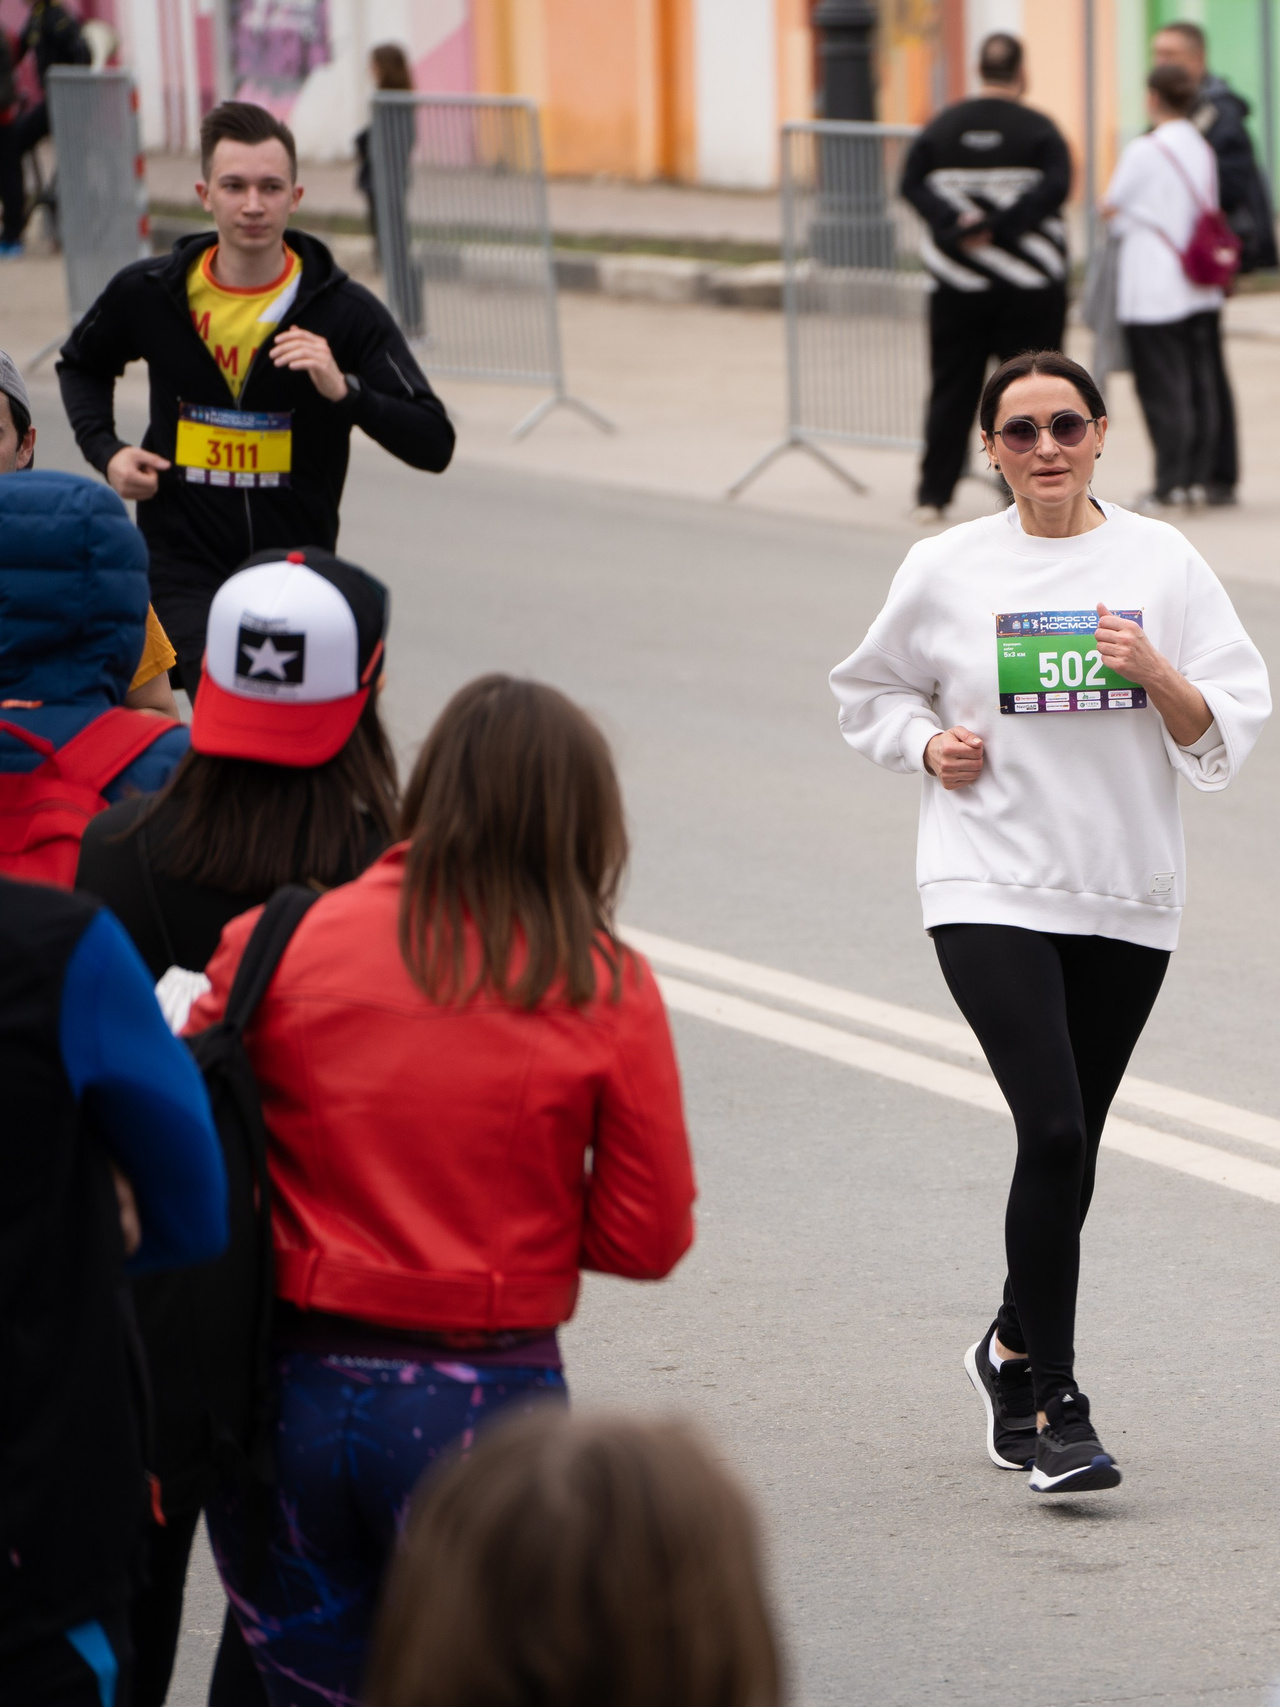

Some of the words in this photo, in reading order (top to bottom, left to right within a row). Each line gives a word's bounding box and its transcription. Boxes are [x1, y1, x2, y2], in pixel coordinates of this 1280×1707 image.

[206, 439, 258, 469] 3111
[1040, 622, 1098, 630] КОСМОС
[1039, 650, 1106, 688] 502
